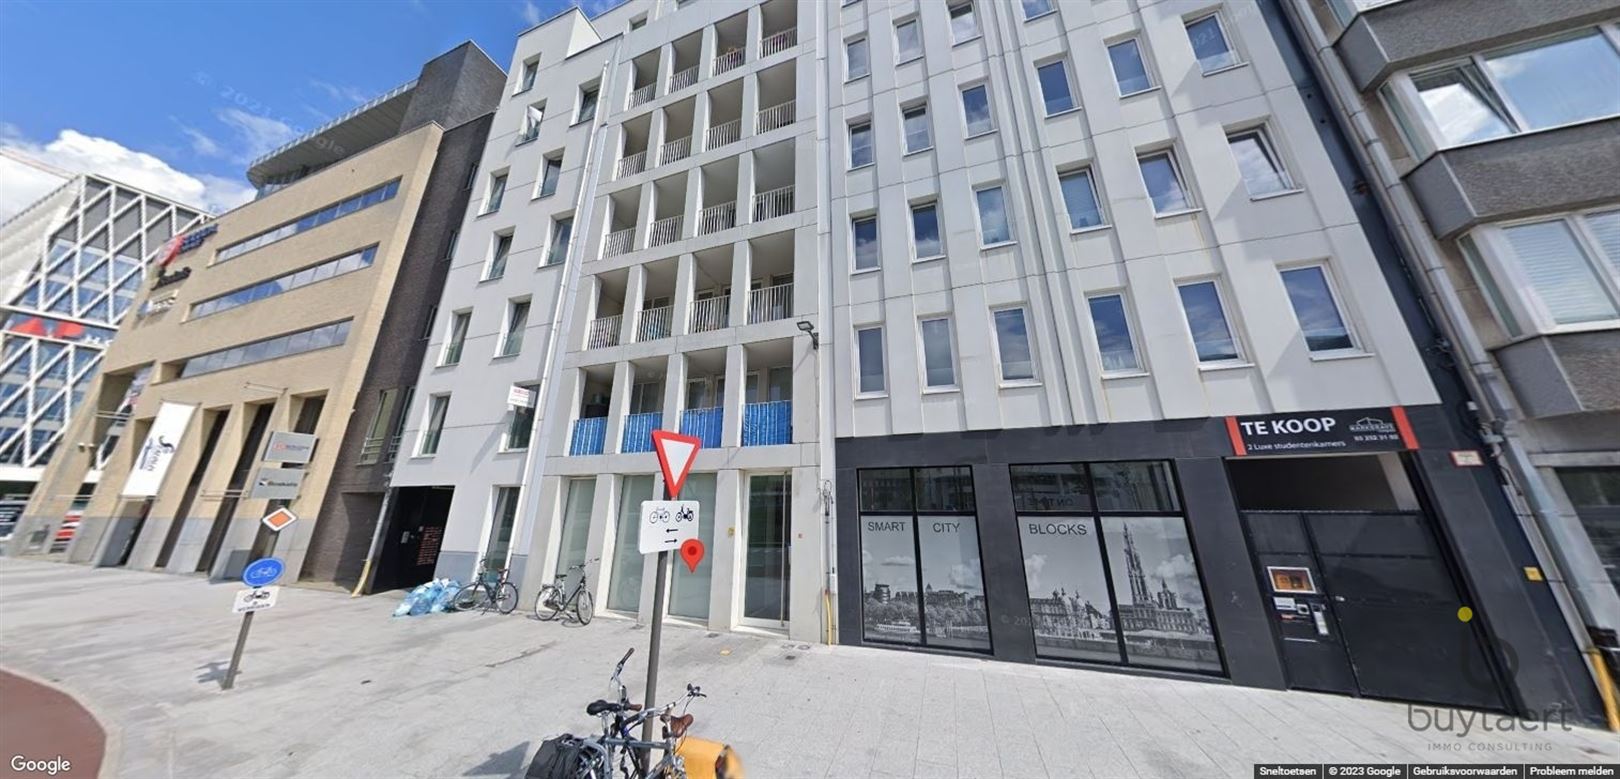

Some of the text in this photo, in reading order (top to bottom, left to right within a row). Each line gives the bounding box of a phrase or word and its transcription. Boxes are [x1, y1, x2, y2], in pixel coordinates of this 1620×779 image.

[1240, 416, 1336, 436] TE KOOP
[1254, 443, 1273, 451] Luxe
[1274, 440, 1347, 450] studentenkamers
[867, 521, 1088, 536] SMART CITY BLOCKS
